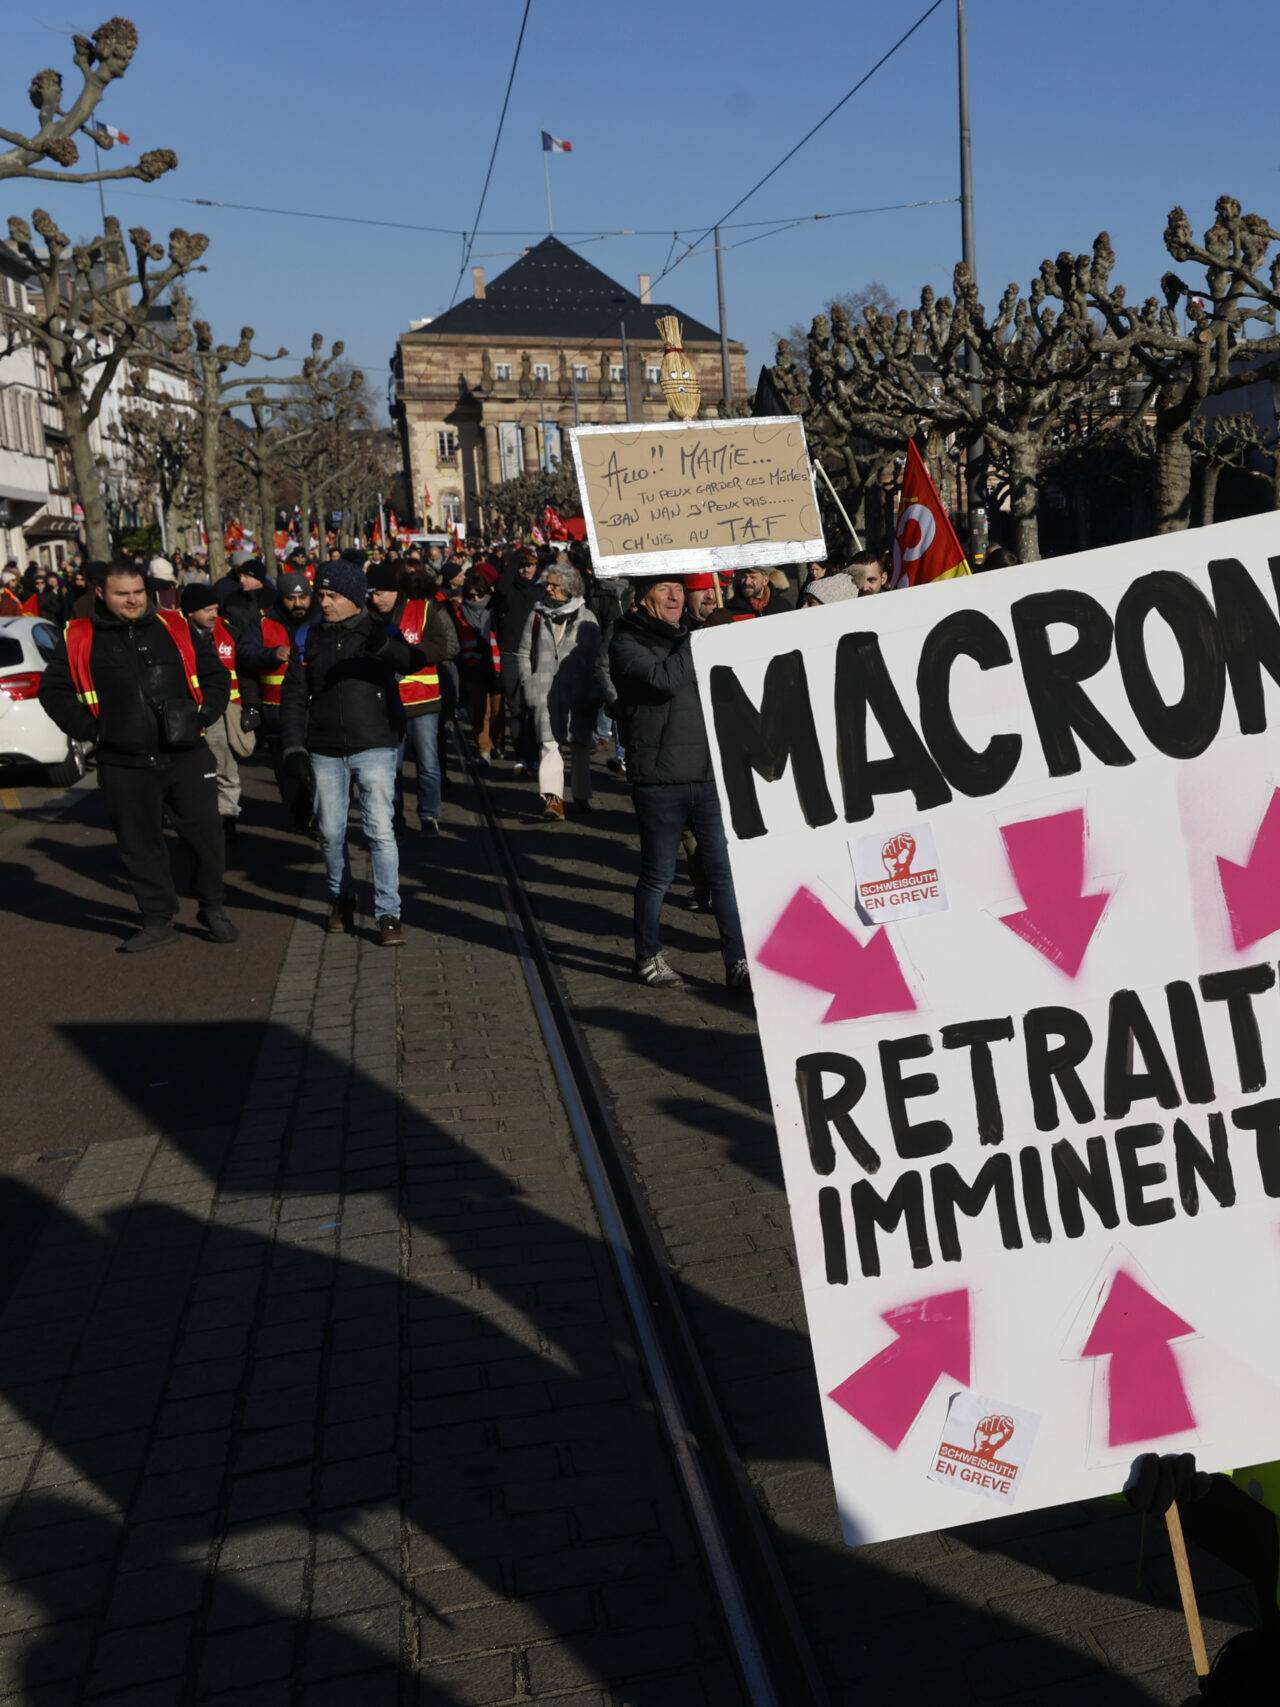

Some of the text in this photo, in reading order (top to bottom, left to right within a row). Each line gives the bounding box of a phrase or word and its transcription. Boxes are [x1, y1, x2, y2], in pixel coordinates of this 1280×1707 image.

[637, 492, 655, 504] TU
[659, 488, 692, 500] PEUX
[696, 477, 742, 496] GARDER
[746, 477, 765, 486] LES
[651, 503, 681, 521] NAN
[690, 529, 709, 543] AU
[717, 514, 787, 542] TAF
[861, 872, 937, 896] SCHWEISGUTH
[865, 885, 940, 911] EN GREVE
[940, 1446, 1017, 1479] SCHWEISGUTH
[935, 1460, 1012, 1495] EN GREVE
